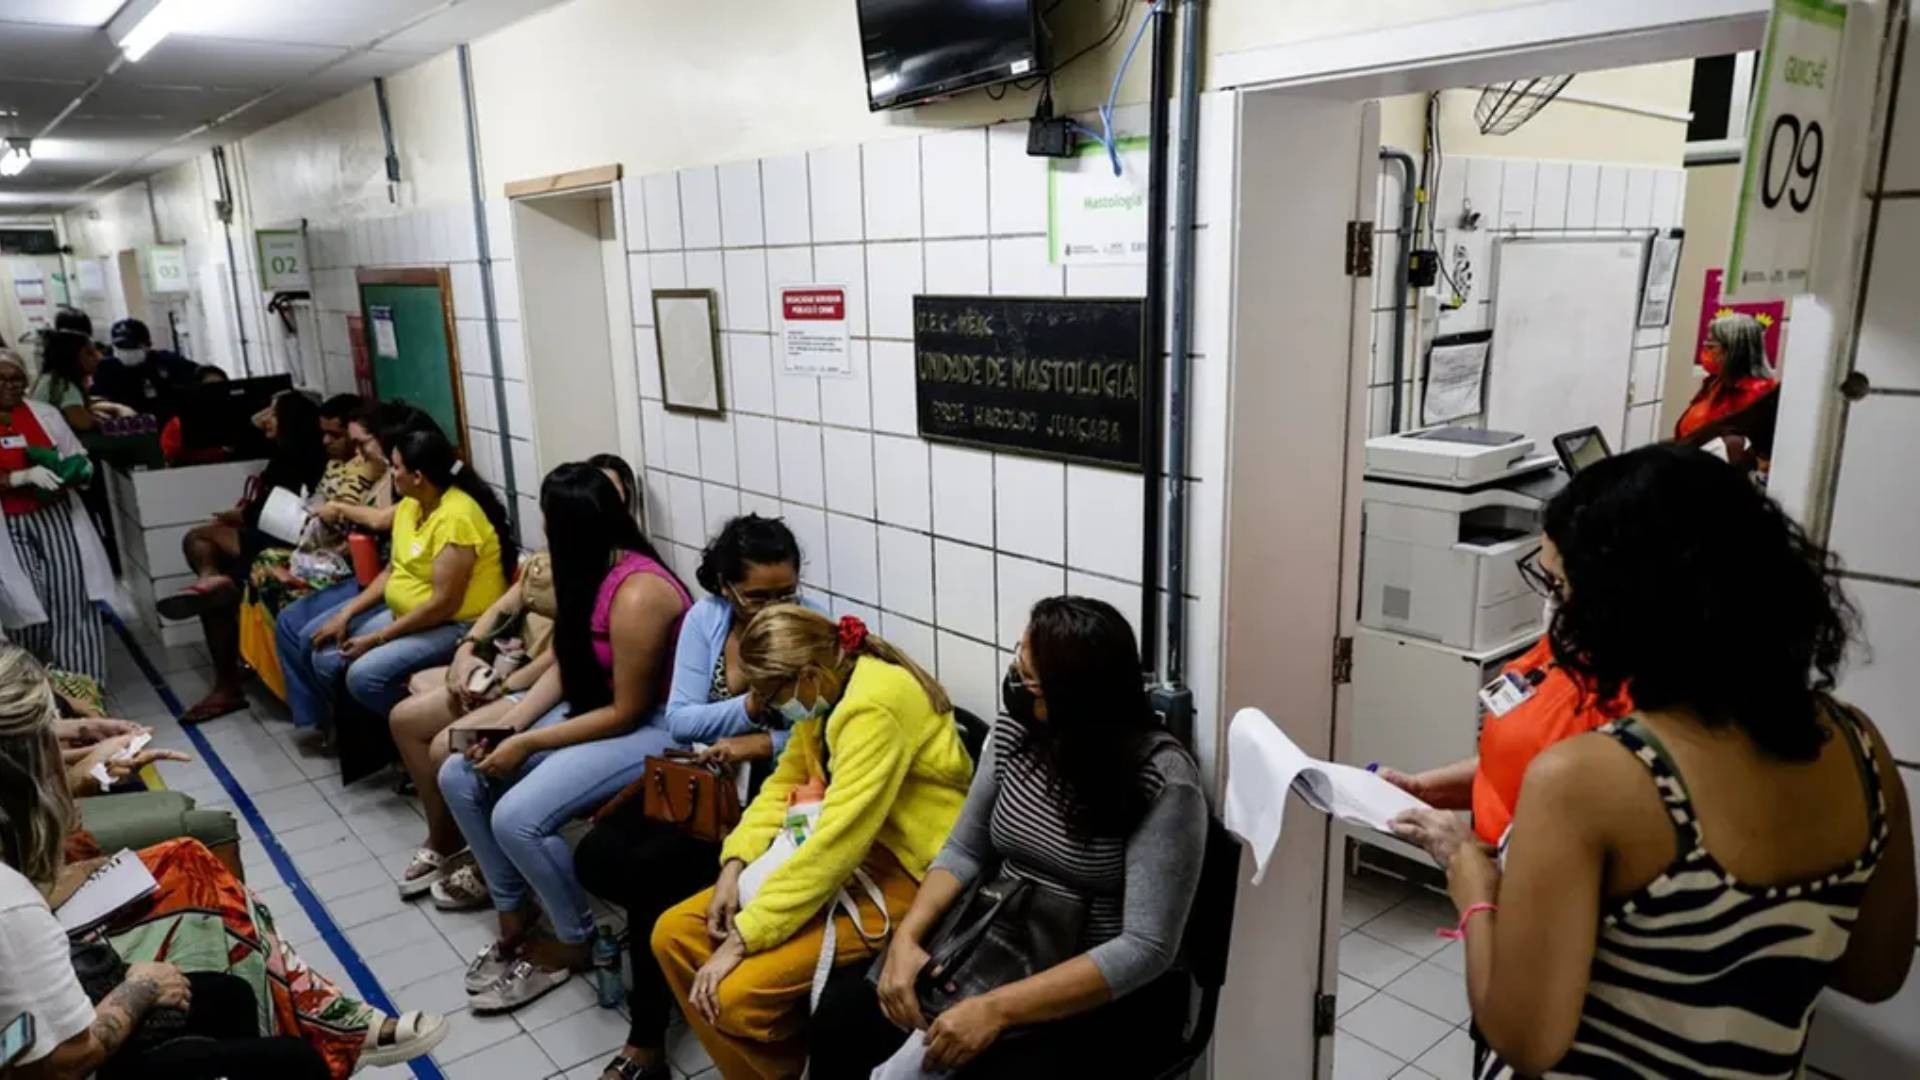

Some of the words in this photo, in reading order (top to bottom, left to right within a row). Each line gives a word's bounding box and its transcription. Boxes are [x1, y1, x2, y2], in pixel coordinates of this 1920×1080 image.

[1762, 113, 1824, 213] 09
[1083, 192, 1143, 210] Mastologia
[271, 256, 298, 274] 02
[918, 351, 982, 386] UNIDADE
[985, 355, 1008, 388] DE
[1012, 358, 1138, 399] MASTOLOGIA
[973, 404, 1038, 433] HAROLDO
